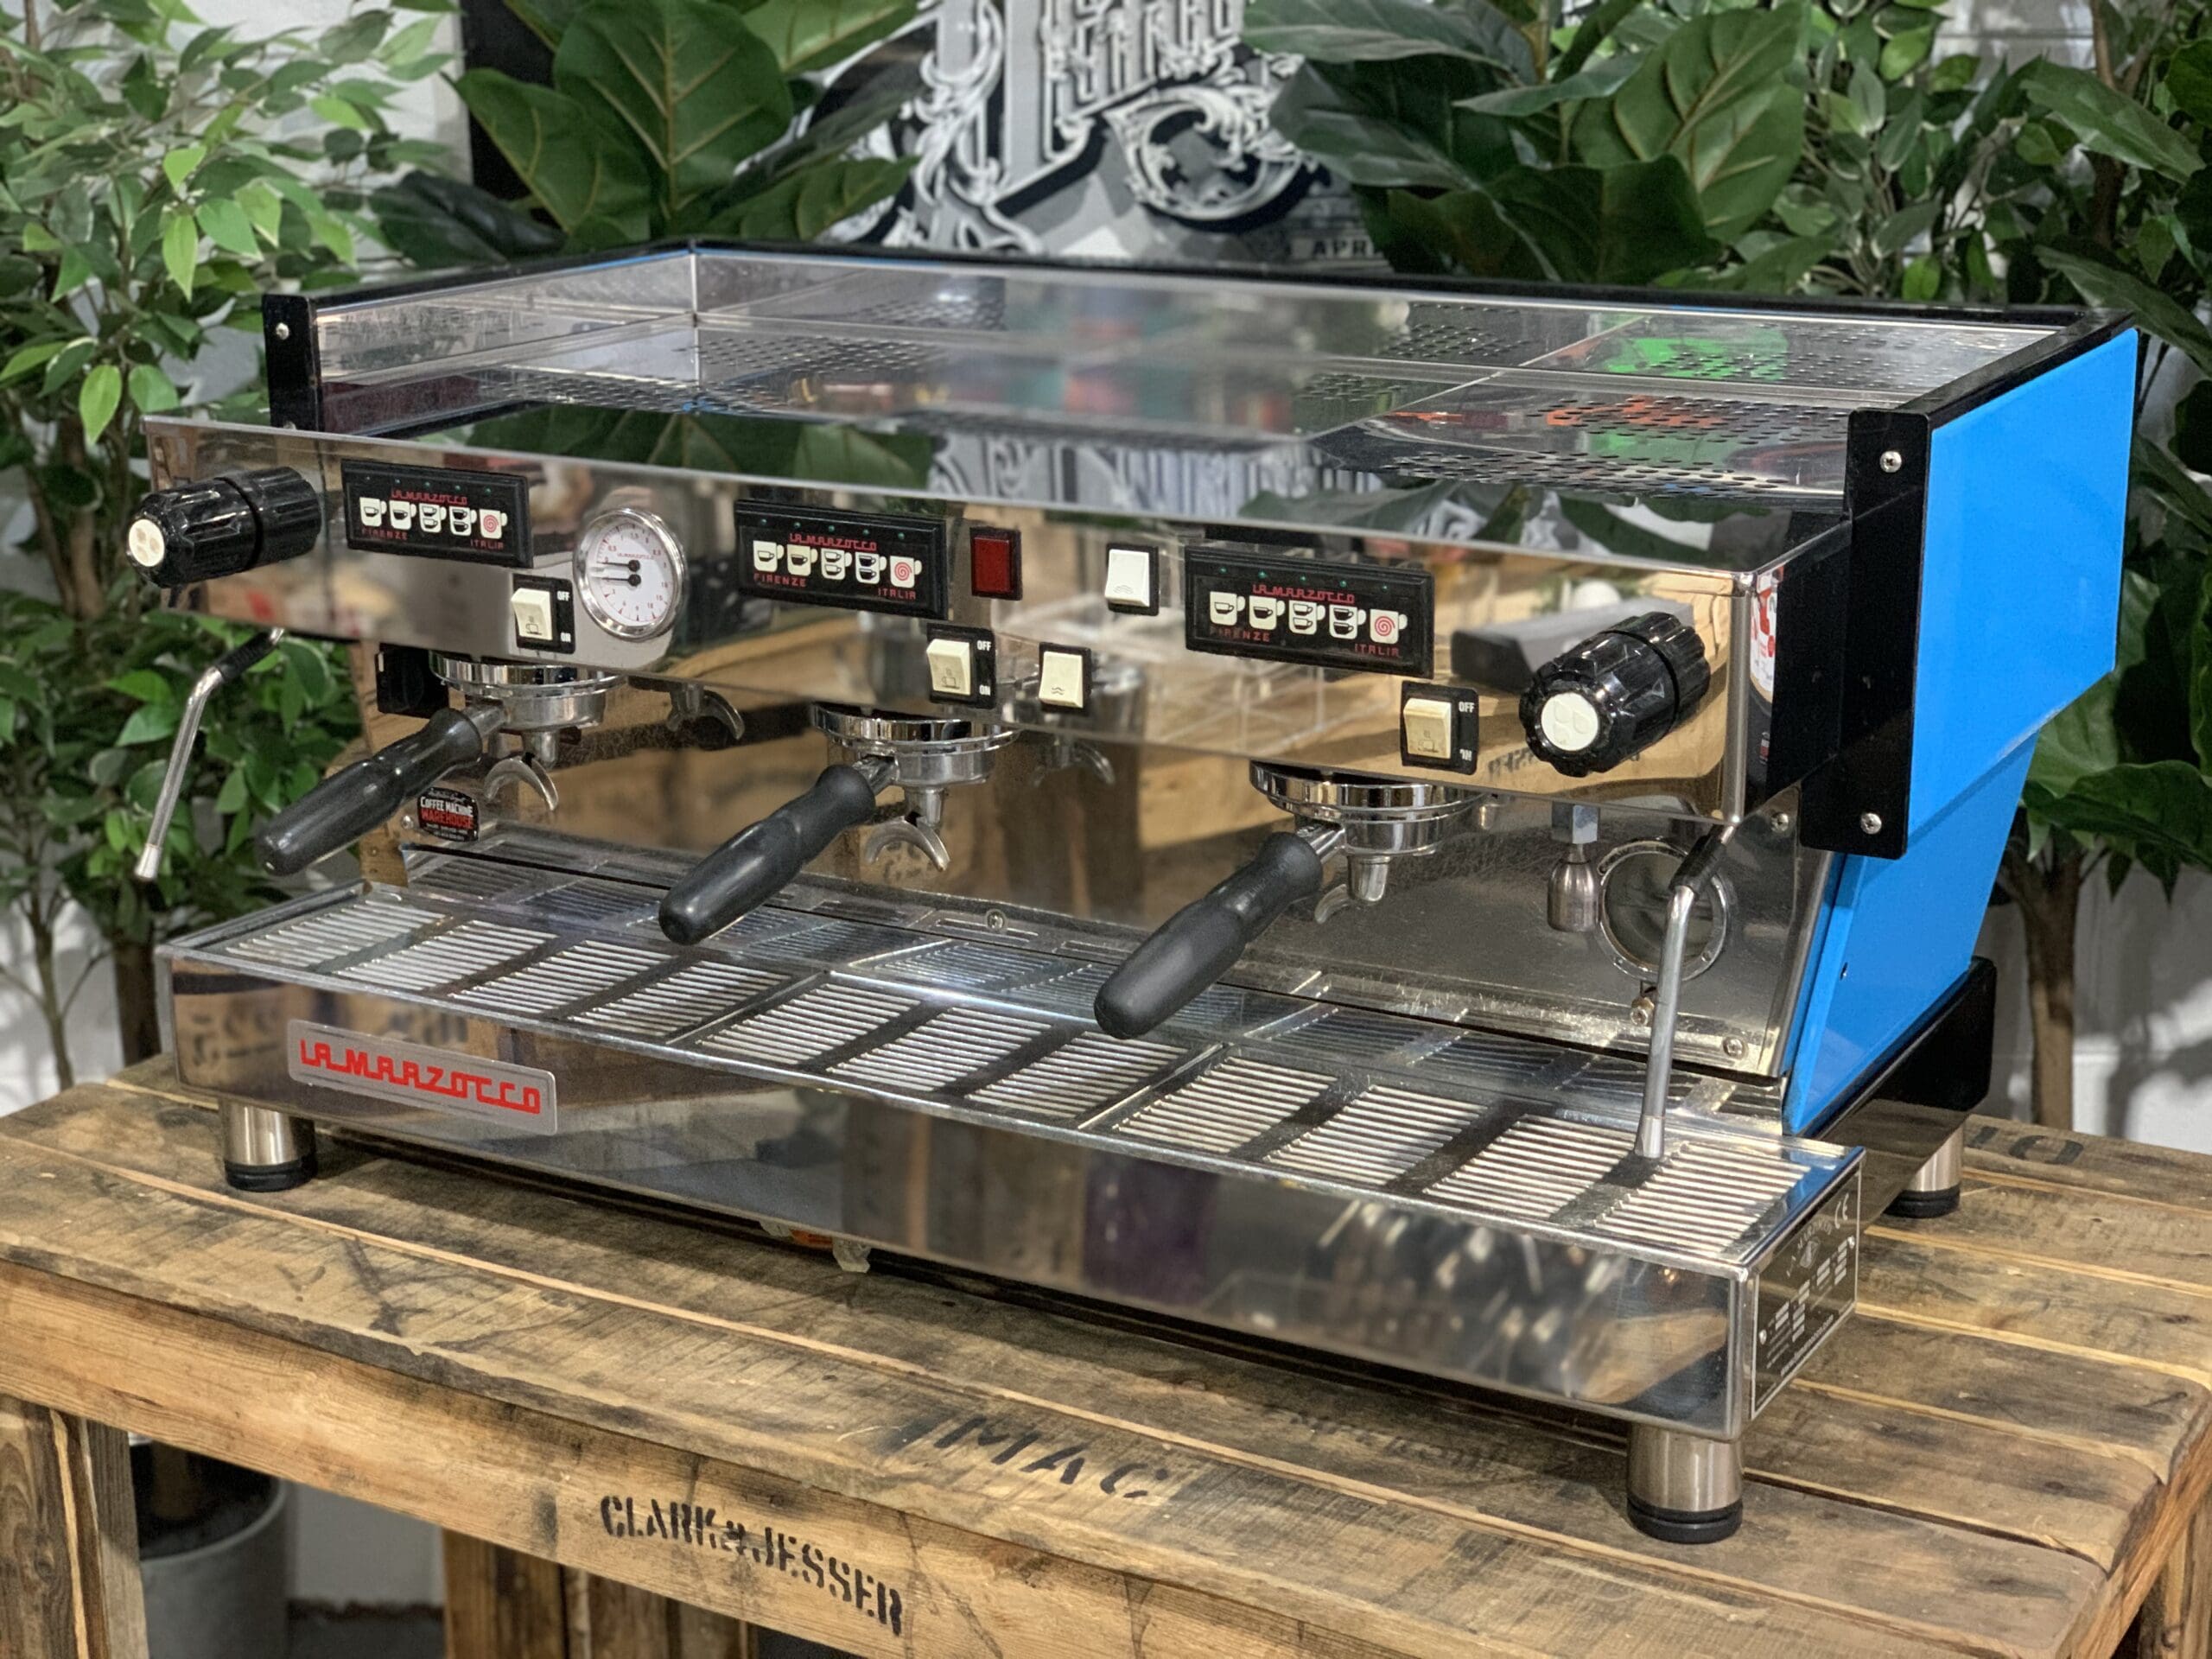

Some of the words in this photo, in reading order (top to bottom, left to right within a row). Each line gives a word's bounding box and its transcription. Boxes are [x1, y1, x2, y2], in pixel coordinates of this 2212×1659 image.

[361, 527, 408, 541] FIRENZE
[469, 538, 505, 550] ITALIA
[753, 573, 807, 588] FIRENZE
[556, 590, 570, 601] OFF
[878, 588, 916, 600] ITALIA
[560, 632, 571, 643] ON
[1210, 625, 1270, 642] FIRENZE
[976, 639, 992, 652] OFF
[1355, 643, 1400, 658] ITALIA
[979, 684, 991, 696] ON
[1458, 701, 1475, 714] OFF
[420, 796, 444, 812] COFFEE
[421, 808, 474, 830] WAREHOUSE
